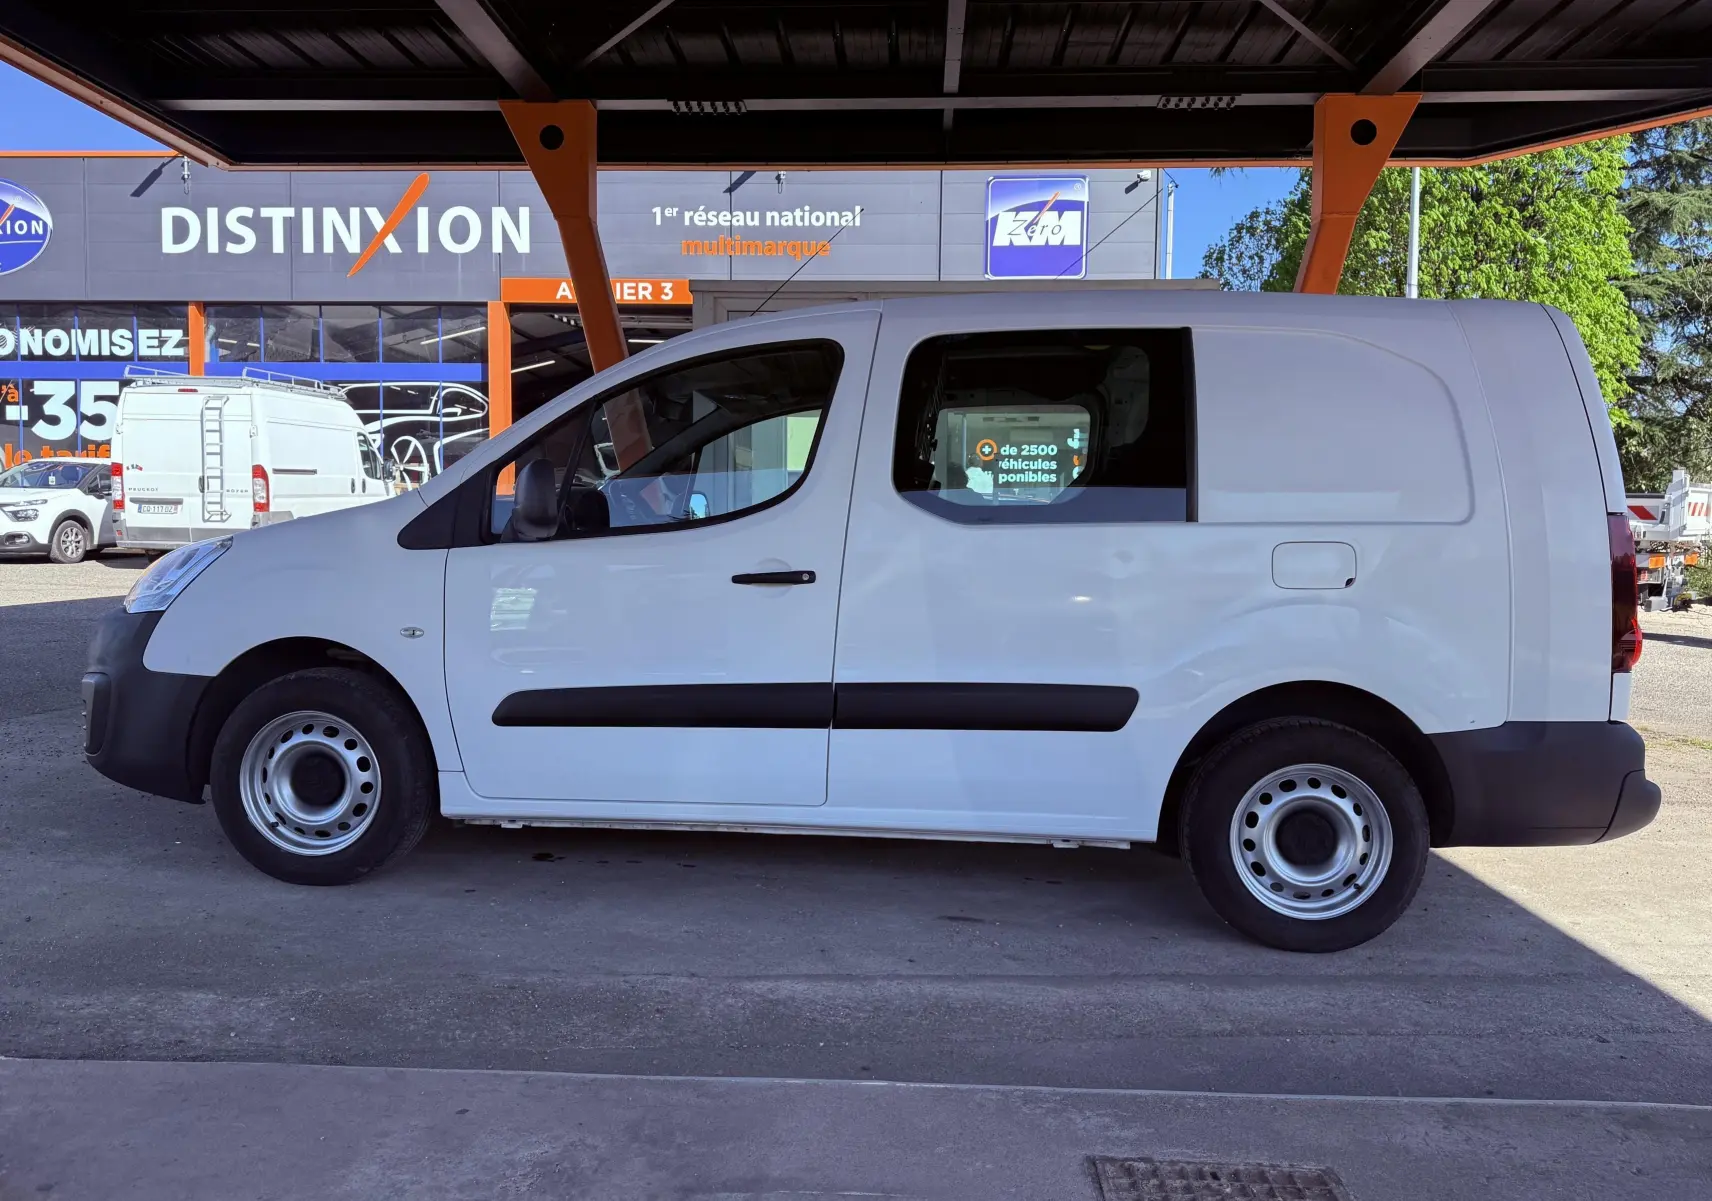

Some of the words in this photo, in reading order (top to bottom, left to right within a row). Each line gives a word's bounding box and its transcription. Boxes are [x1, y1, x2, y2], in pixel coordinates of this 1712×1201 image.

[160, 173, 531, 276] DISTINXION
[683, 205, 760, 227] réseau
[765, 205, 861, 227] national
[681, 234, 831, 261] multimarque
[555, 281, 653, 301] AIER
[660, 282, 674, 301] 3
[1000, 444, 1018, 456] de
[1020, 444, 1058, 456] 2500
